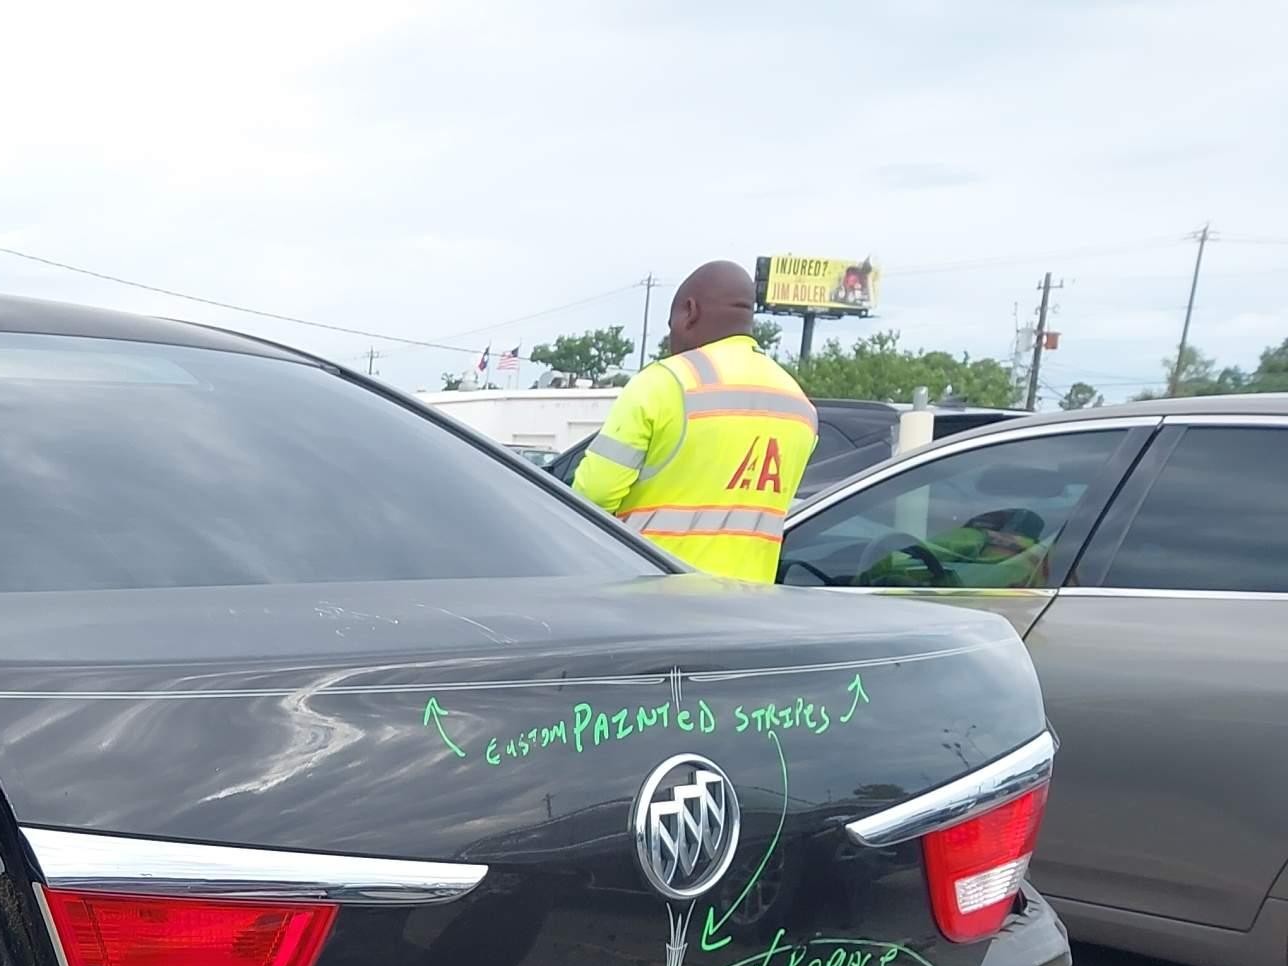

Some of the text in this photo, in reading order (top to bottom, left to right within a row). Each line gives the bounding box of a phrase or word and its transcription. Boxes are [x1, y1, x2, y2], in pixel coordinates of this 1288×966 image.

[776, 258, 829, 277] INJURED?
[772, 283, 826, 303] JIM ADLER
